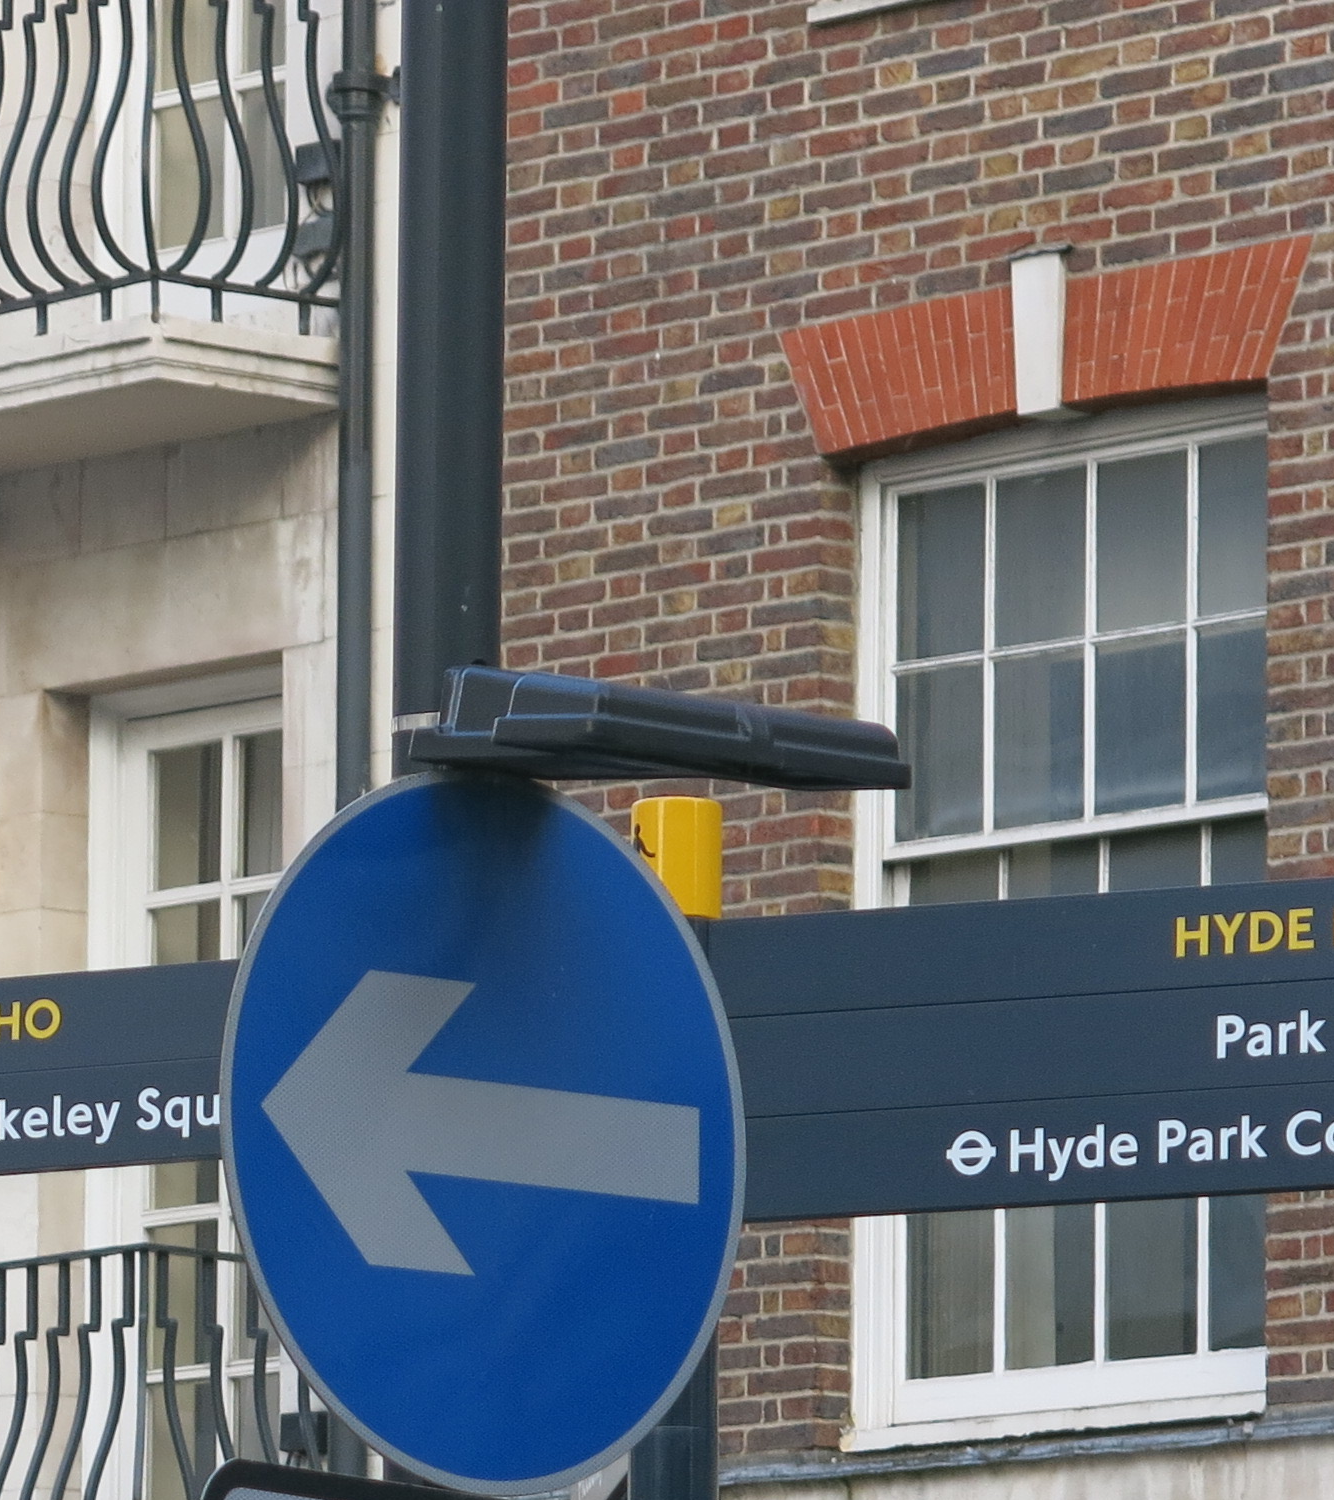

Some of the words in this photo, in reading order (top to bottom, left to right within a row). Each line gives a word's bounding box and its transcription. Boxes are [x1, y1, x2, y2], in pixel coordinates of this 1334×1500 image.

[1174, 907, 1316, 959] HYDE
[1215, 1008, 1327, 1060] Park
[135, 1086, 221, 1138] Squ
[1008, 1123, 1139, 1182] Hyde
[1157, 1114, 1268, 1165] Park
